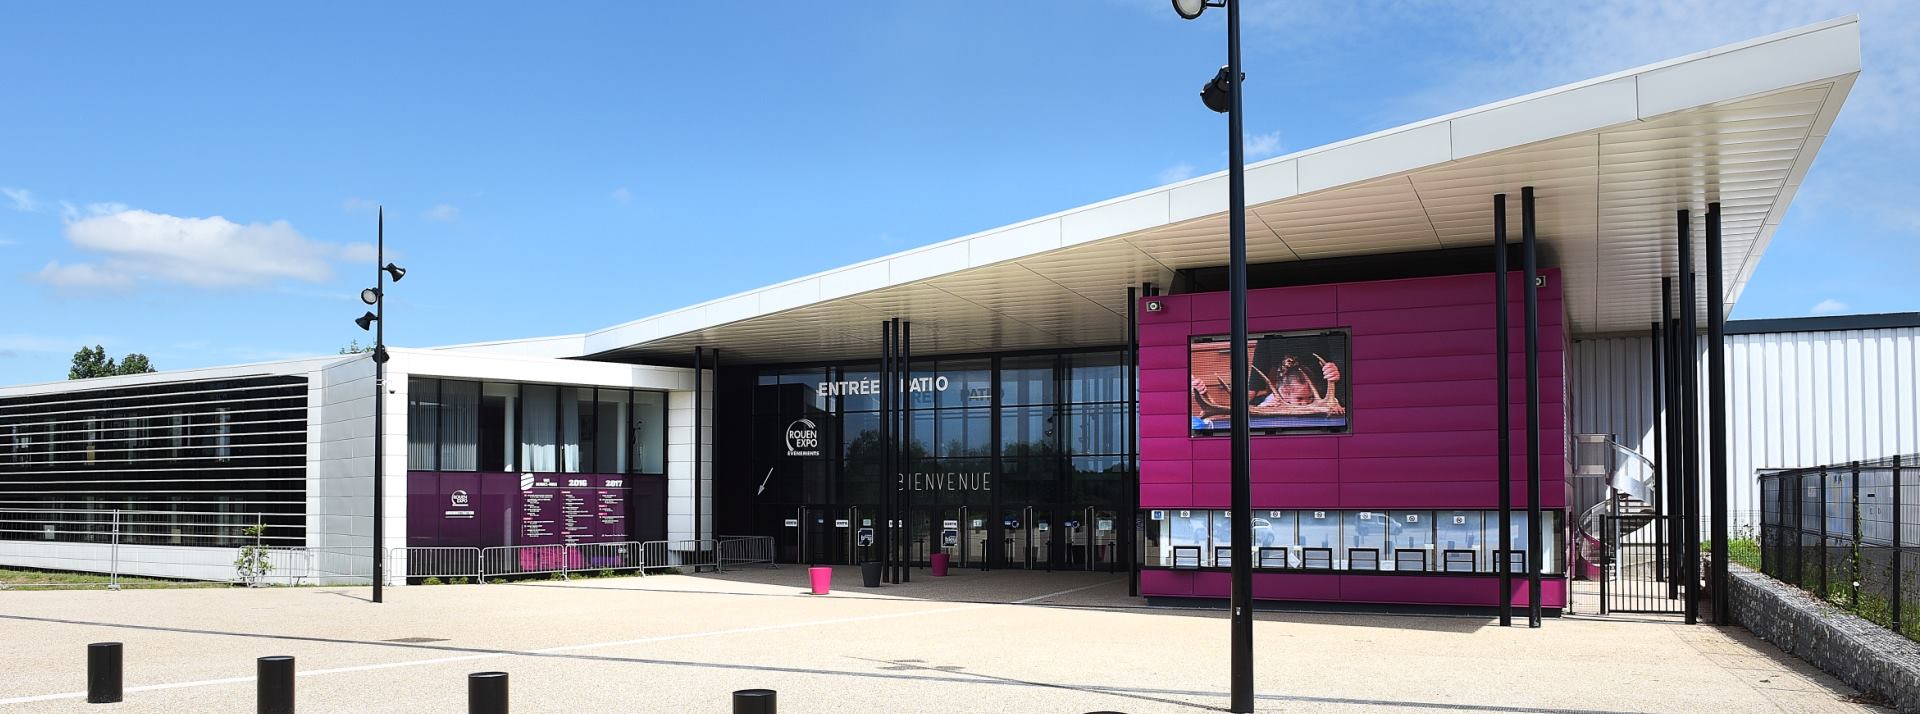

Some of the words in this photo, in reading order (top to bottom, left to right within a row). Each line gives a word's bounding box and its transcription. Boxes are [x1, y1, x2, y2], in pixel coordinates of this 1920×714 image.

[818, 377, 880, 397] ENTRÉE
[789, 430, 817, 439] ROUEN
[796, 439, 818, 448] EXPO
[568, 479, 588, 487] 2016
[898, 472, 991, 491] BIENVENUE
